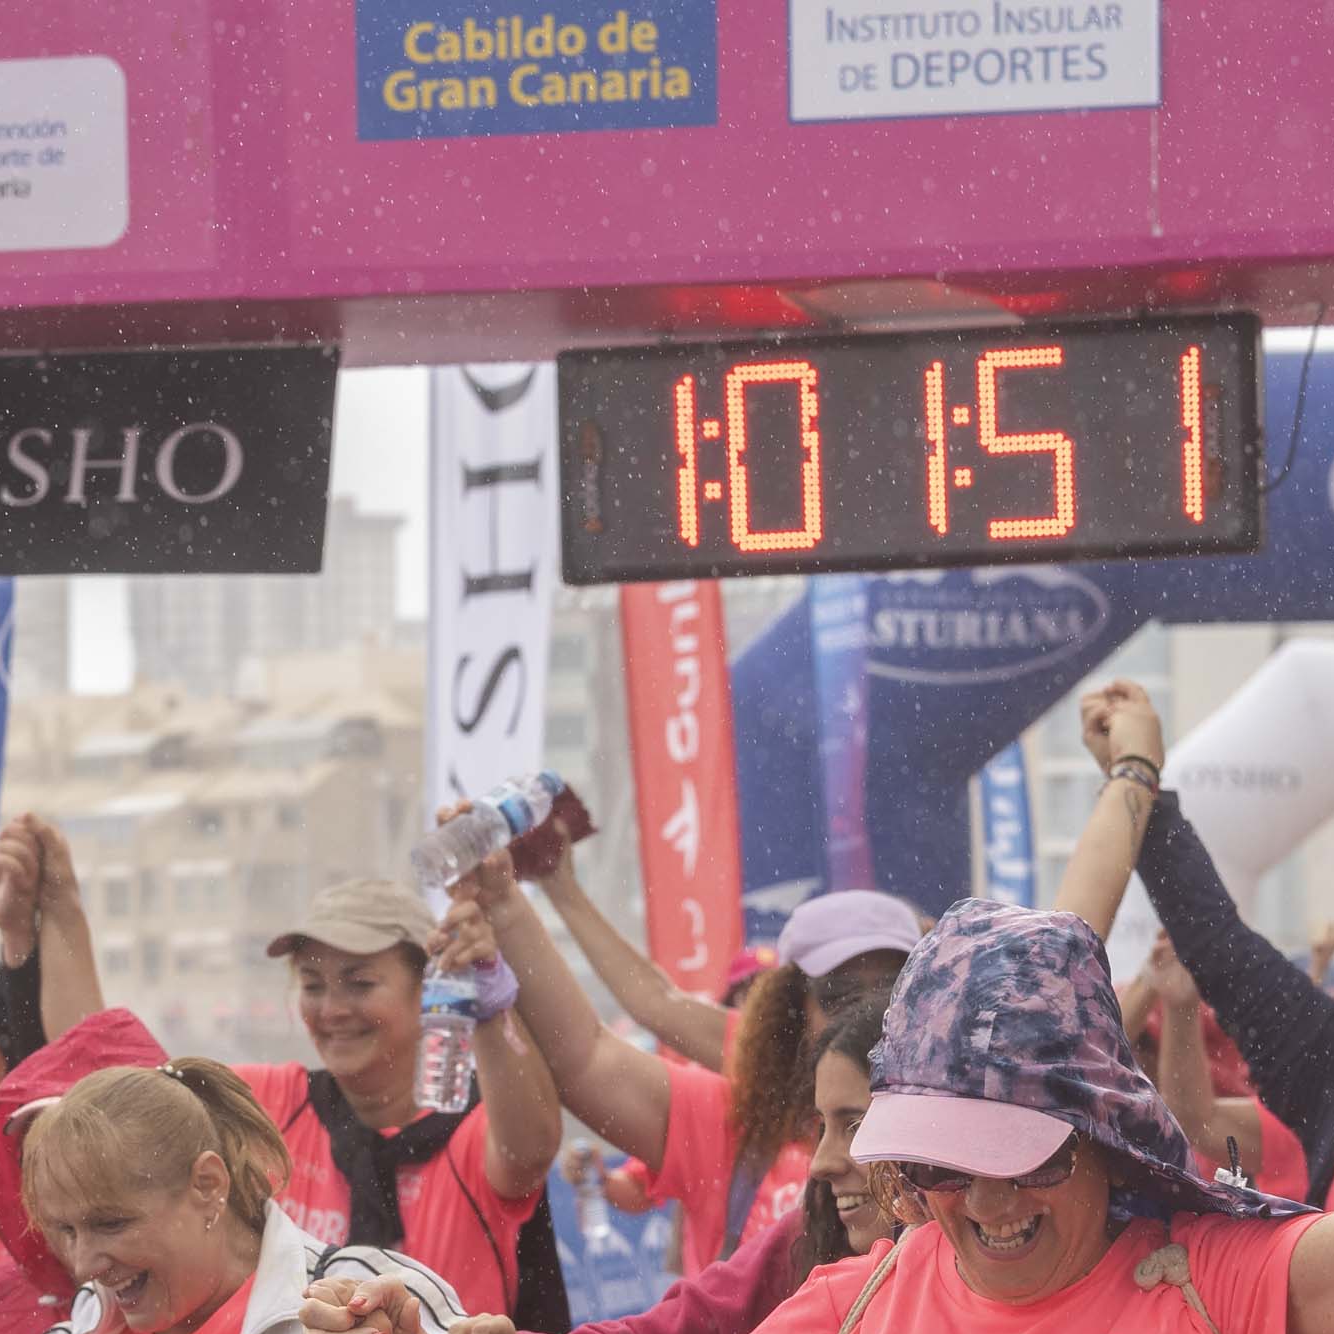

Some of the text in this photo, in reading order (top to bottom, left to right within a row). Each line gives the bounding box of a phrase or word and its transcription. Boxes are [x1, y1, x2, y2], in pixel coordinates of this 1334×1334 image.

[403, 10, 658, 64] Cabildo de
[382, 58, 691, 112] Gran Canaria
[890, 43, 1108, 90] DEPORTES
[38, 146, 65, 166] de
